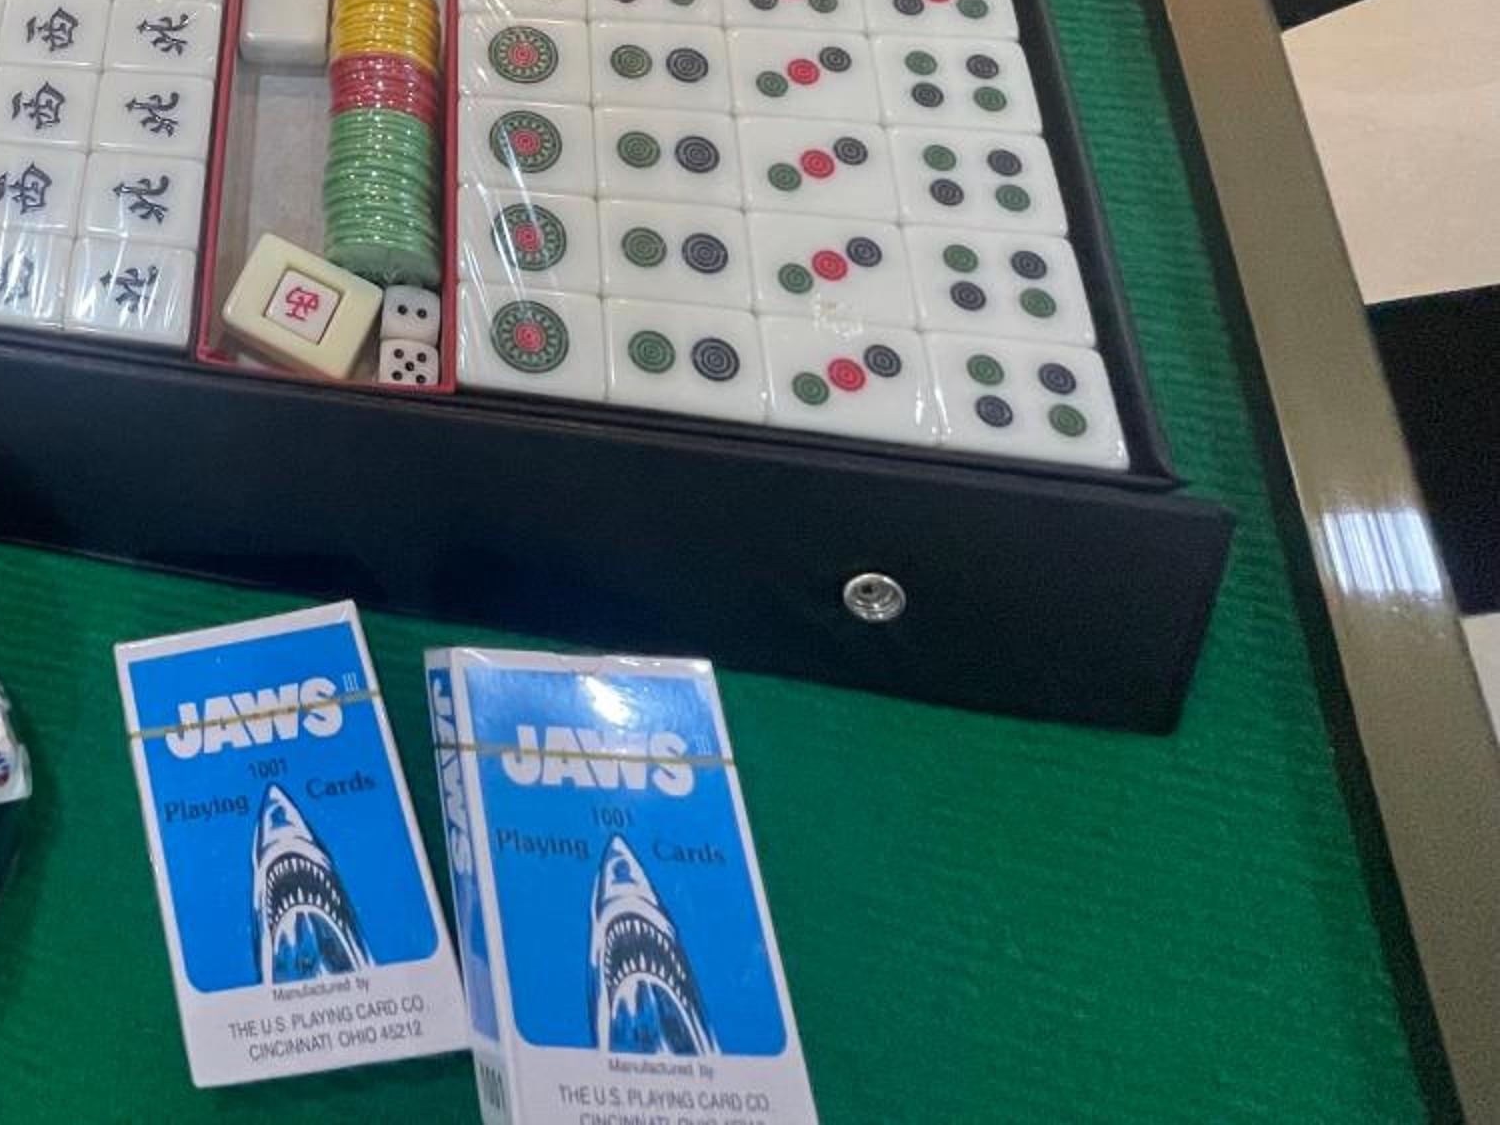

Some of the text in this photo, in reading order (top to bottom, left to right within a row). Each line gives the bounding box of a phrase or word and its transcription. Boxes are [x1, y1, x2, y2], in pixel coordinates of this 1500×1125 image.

[25, 6, 81, 53] 西
[135, 12, 190, 56] 北
[11, 80, 68, 131] 西
[124, 91, 181, 139] 北
[112, 175, 169, 225] 北
[165, 677, 343, 759] JAWS
[247, 757, 289, 780] 1001
[432, 677, 475, 876] JAWS
[501, 724, 695, 797] JAWS
[164, 769, 377, 823] Playing Cards
[593, 805, 634, 828] 1001
[495, 827, 726, 864] Playing Cards
[272, 977, 370, 1002] Manufactured by
[228, 1020, 259, 1040] THE
[291, 1004, 354, 1030] PLAYING
[355, 998, 398, 1021] CARD
[249, 1020, 423, 1062] CINCINNATI OHIO 45212
[608, 1058, 716, 1080] Manufactured by
[558, 1084, 592, 1104] THE
[627, 1088, 695, 1110] PLAYING
[698, 1091, 742, 1112] CARD
